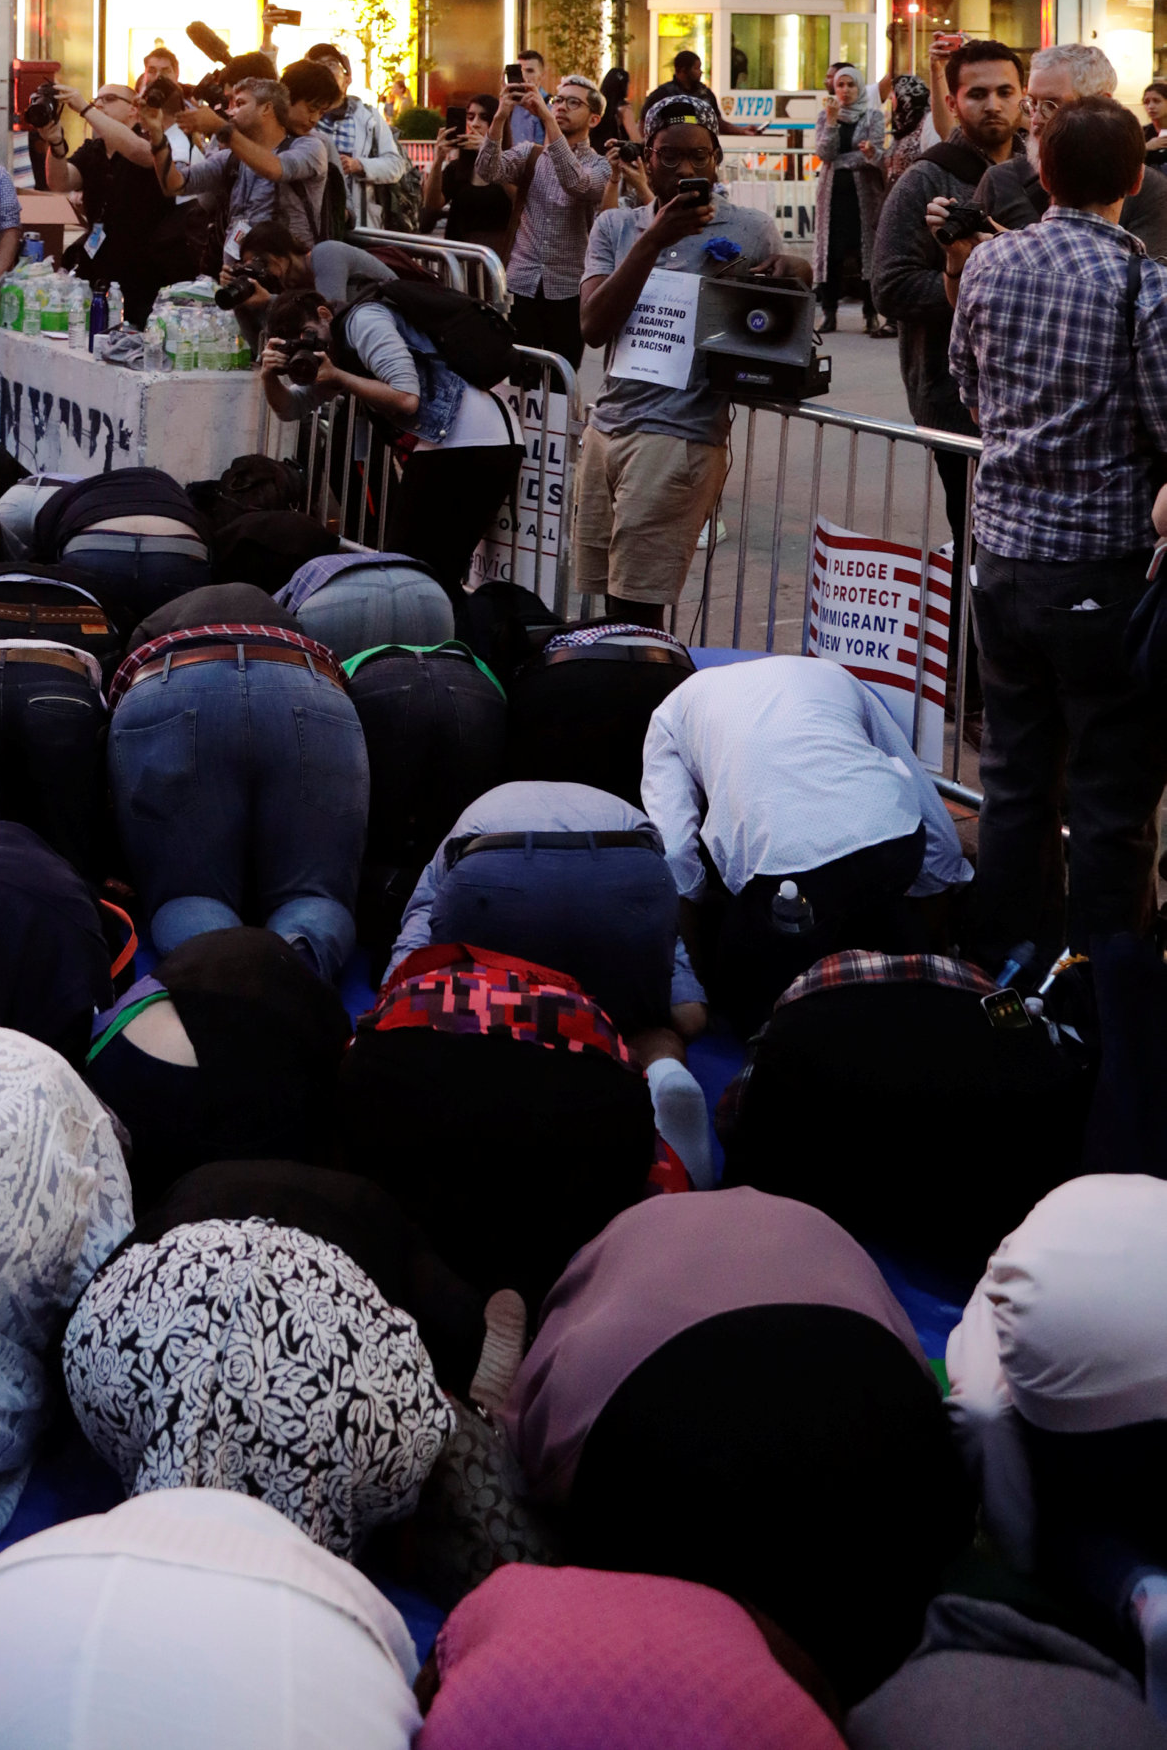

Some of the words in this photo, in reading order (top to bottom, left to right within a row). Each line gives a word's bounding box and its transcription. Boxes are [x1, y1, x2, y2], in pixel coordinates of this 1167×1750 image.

[735, 96, 773, 117] NYPD
[633, 303, 656, 314] JEWS
[657, 305, 687, 320] STAND
[638, 316, 675, 330] AGAINST
[625, 326, 686, 345] ISLAMOPHOBIA
[630, 339, 637, 348] &
[638, 340, 672, 354] RACISM
[526, 523, 556, 541] AL
[828, 558, 832, 574] I
[834, 559, 888, 580] PLEDGE
[822, 581, 831, 598] TO
[833, 585, 902, 609] PROTECT
[819, 605, 899, 635] IMMIGRANT
[819, 631, 841, 652] NEW
[846, 637, 891, 661] YORK
